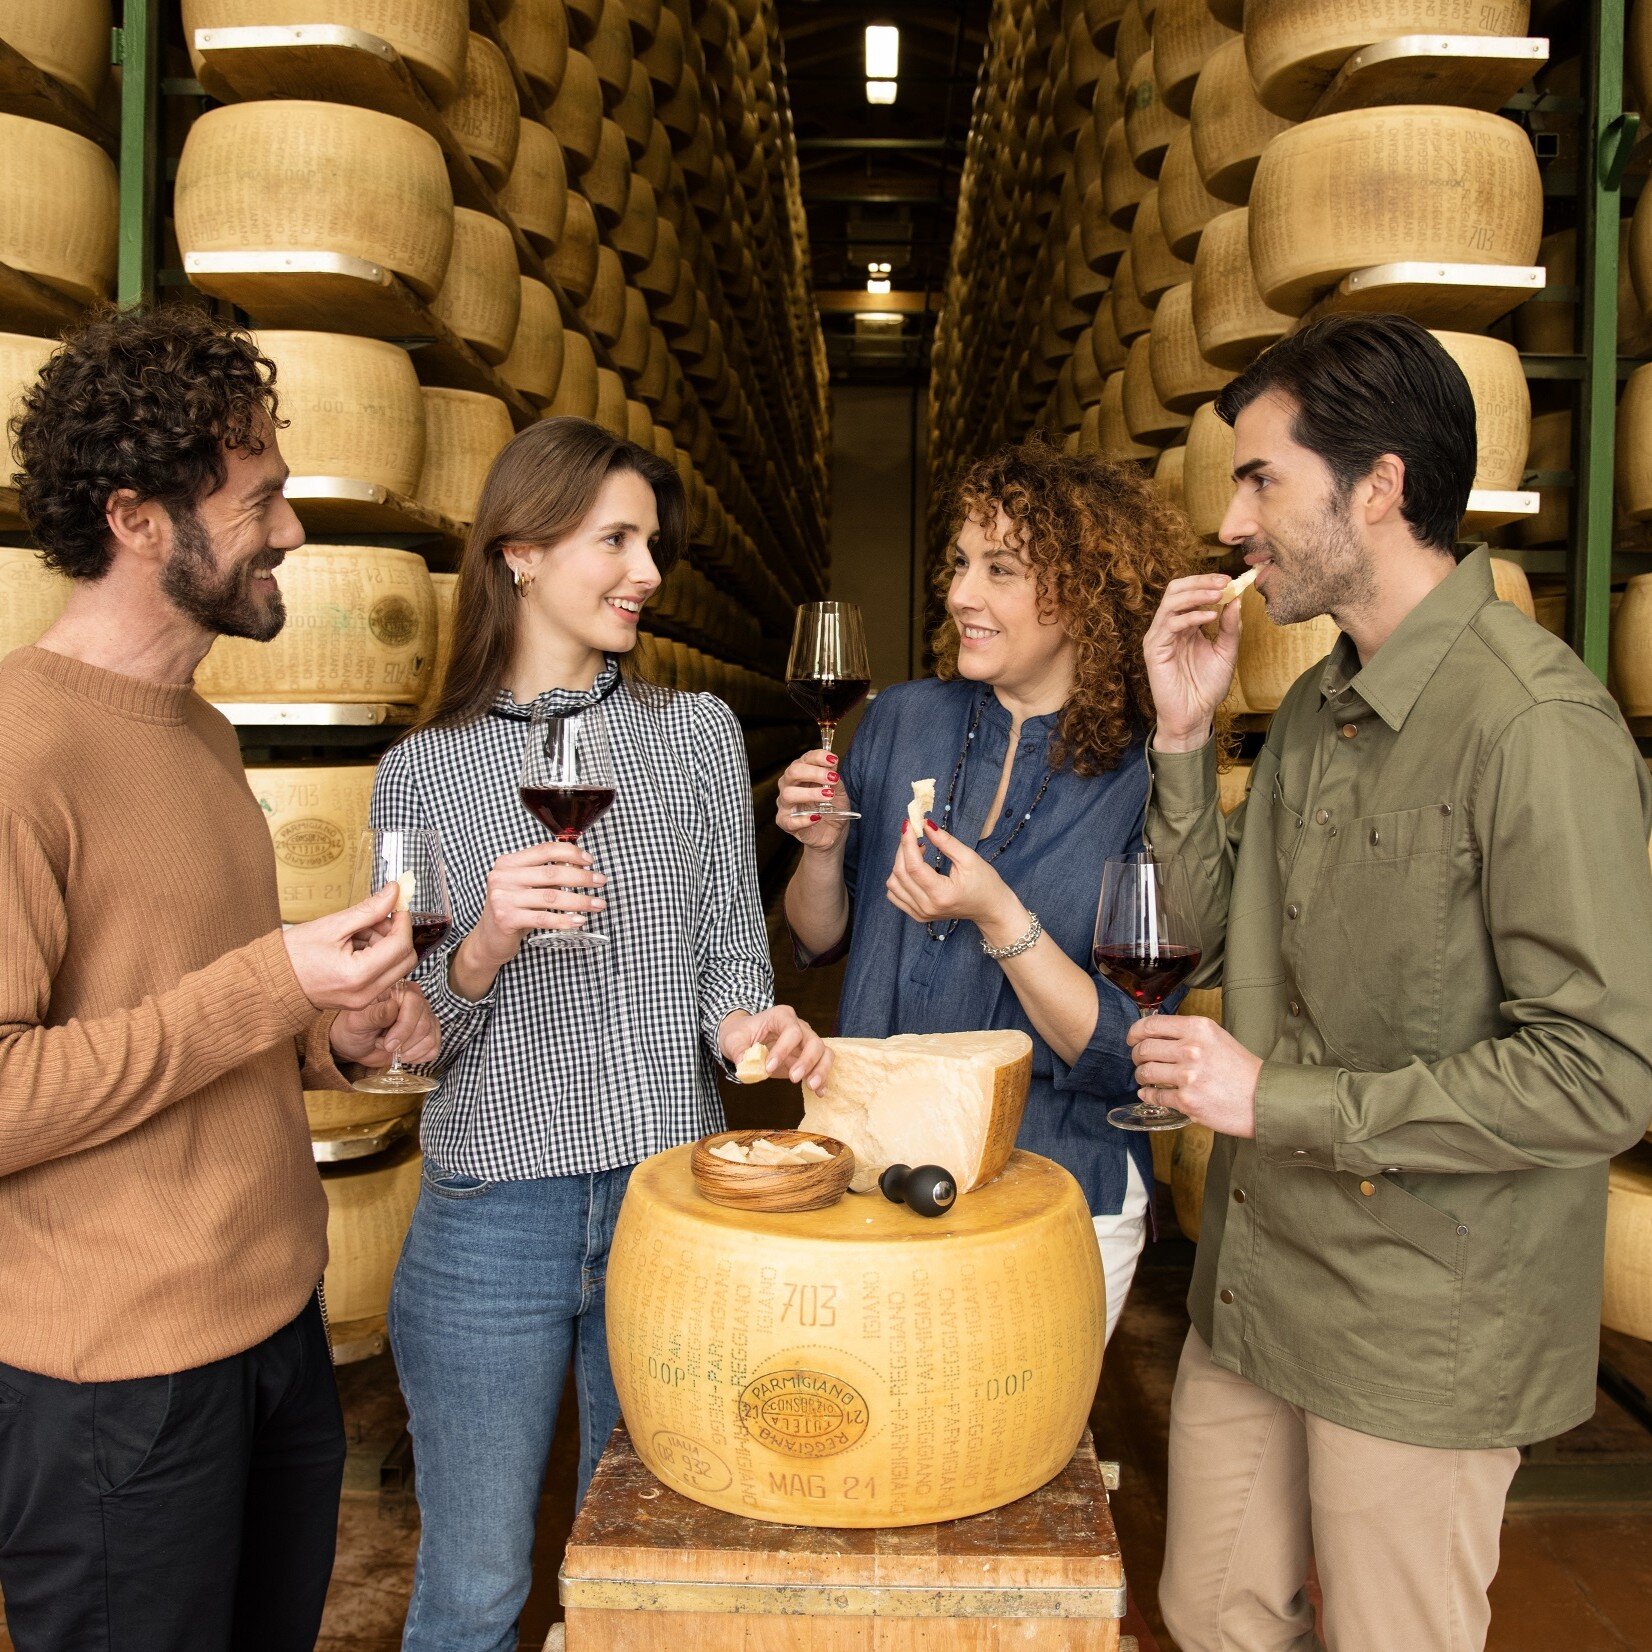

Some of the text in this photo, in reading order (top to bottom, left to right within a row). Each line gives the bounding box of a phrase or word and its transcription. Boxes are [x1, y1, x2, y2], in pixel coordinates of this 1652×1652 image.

[1467, 226, 1495, 252] 703
[288, 784, 318, 807] 703
[284, 884, 342, 901] SET 21
[780, 1282, 837, 1328] 703
[729, 1283, 752, 1388] REGGIANO
[887, 1290, 908, 1397] REGGIANO
[912, 1267, 934, 1394] PARMIGIANO
[648, 1355, 686, 1388] DOP
[986, 1368, 1034, 1402] DOP
[751, 1373, 855, 1406] PARMIGIANO
[769, 1396, 835, 1414] CONSORZIO
[771, 1416, 834, 1435] TUTELA
[758, 1426, 850, 1456] REGGIANO
[680, 1454, 713, 1479] 932
[769, 1471, 877, 1501] MAG 21
